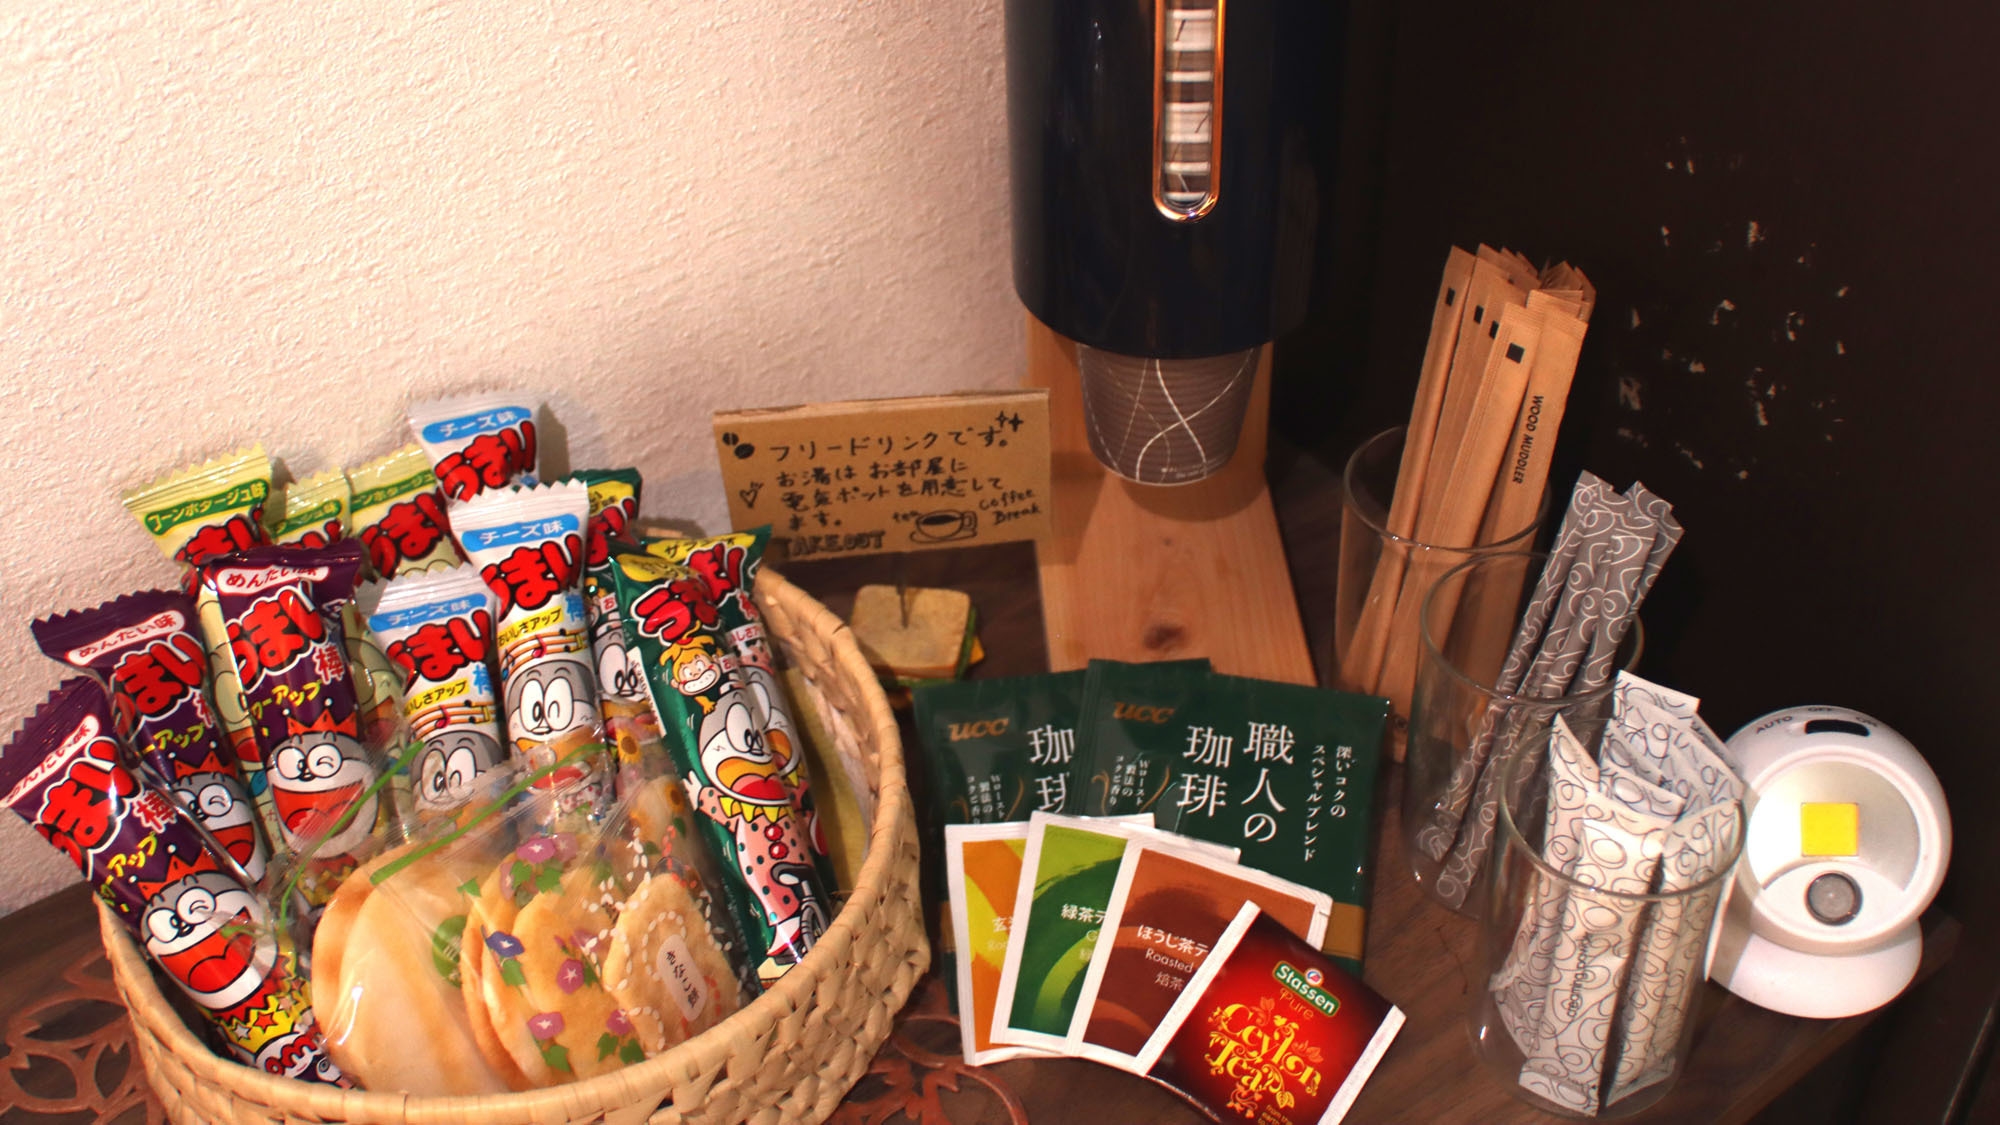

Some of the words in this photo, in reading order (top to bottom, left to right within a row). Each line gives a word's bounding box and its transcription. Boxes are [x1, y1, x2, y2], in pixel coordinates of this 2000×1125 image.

[439, 410, 518, 438] チーズ味
[1526, 395, 1545, 433] WOOD
[434, 420, 536, 503] うまい
[1512, 433, 1535, 485] MUDDLER
[479, 520, 564, 546] チーズ味
[992, 503, 1041, 527] Break
[480, 533, 583, 622] うまい
[388, 599, 472, 626] チーズ味
[79, 614, 176, 659] めんたい味
[315, 643, 344, 682] 棒
[1755, 715, 1793, 735] AUTO
[1175, 724, 1234, 818] 珈琲
[1240, 721, 1296, 843] 職人の
[1329, 745, 1353, 818] 深いコクの
[134, 788, 179, 833] 棒
[992, 916, 1014, 933] 玄
[1060, 903, 1107, 925] 緑茶テ
[1145, 947, 1195, 974] Roasted
[1275, 964, 1336, 1015] Stassen
[1279, 987, 1315, 1020] Pure
[1204, 1031, 1284, 1093] Tea
[1220, 1003, 1322, 1097] Ceylon
